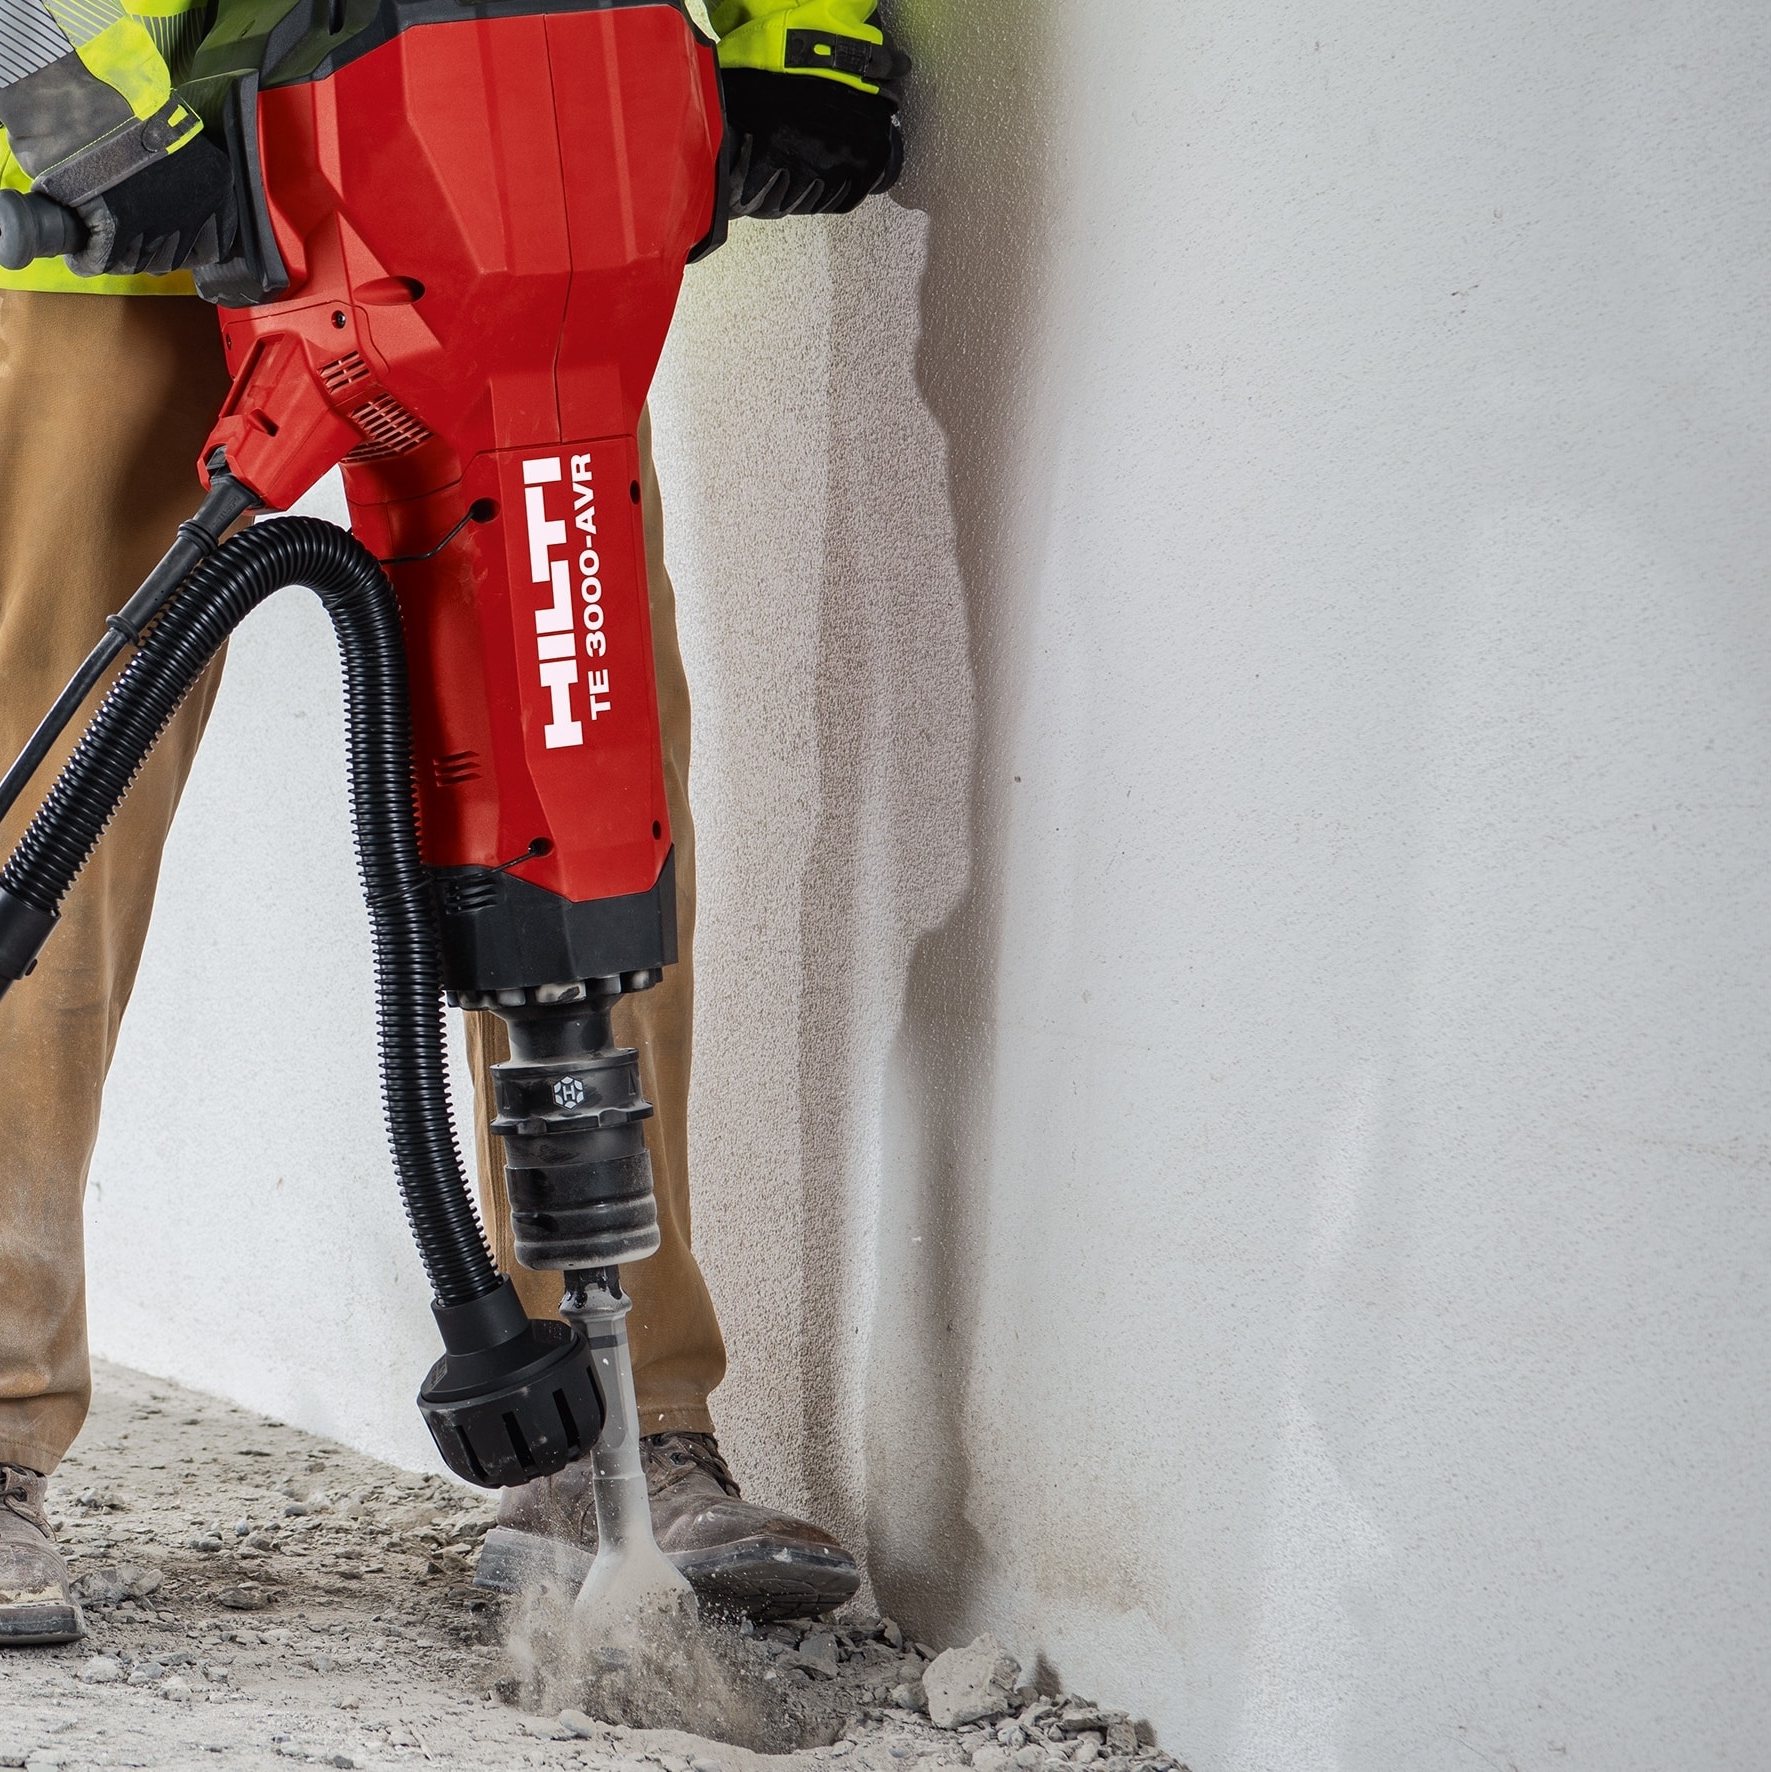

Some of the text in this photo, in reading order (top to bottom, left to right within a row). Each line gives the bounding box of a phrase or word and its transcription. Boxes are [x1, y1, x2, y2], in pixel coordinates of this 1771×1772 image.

[522, 456, 584, 749] HILTI
[570, 453, 611, 721] TE 3000-AVR
